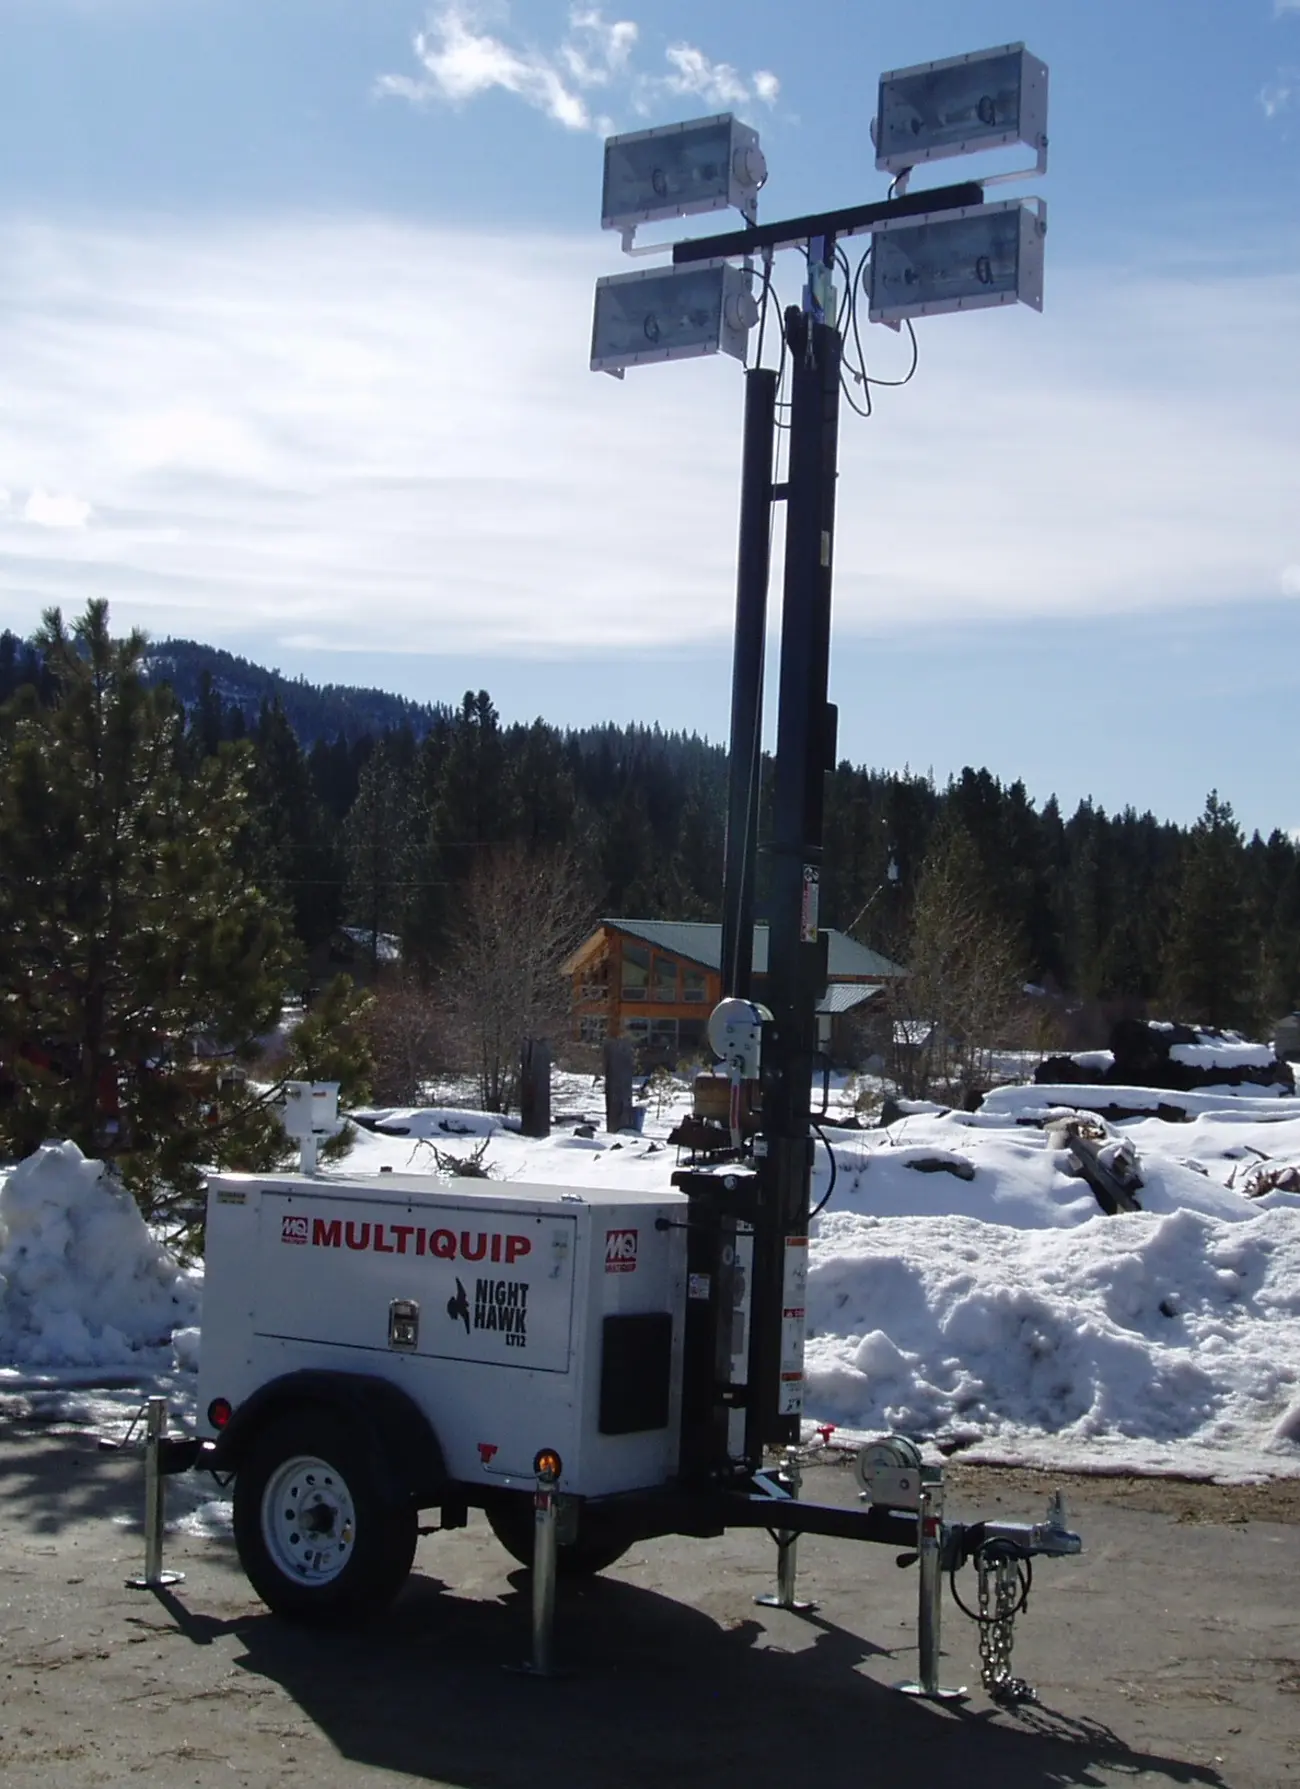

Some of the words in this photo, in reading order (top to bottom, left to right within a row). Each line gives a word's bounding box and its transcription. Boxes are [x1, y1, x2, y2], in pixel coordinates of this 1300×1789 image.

[283, 1218, 307, 1236] MQ
[312, 1219, 532, 1264] MULTIQUIP
[605, 1233, 636, 1258] MQ
[475, 1278, 529, 1308] NIGHT
[474, 1304, 527, 1334] HAWK
[505, 1334, 526, 1347] LT12
